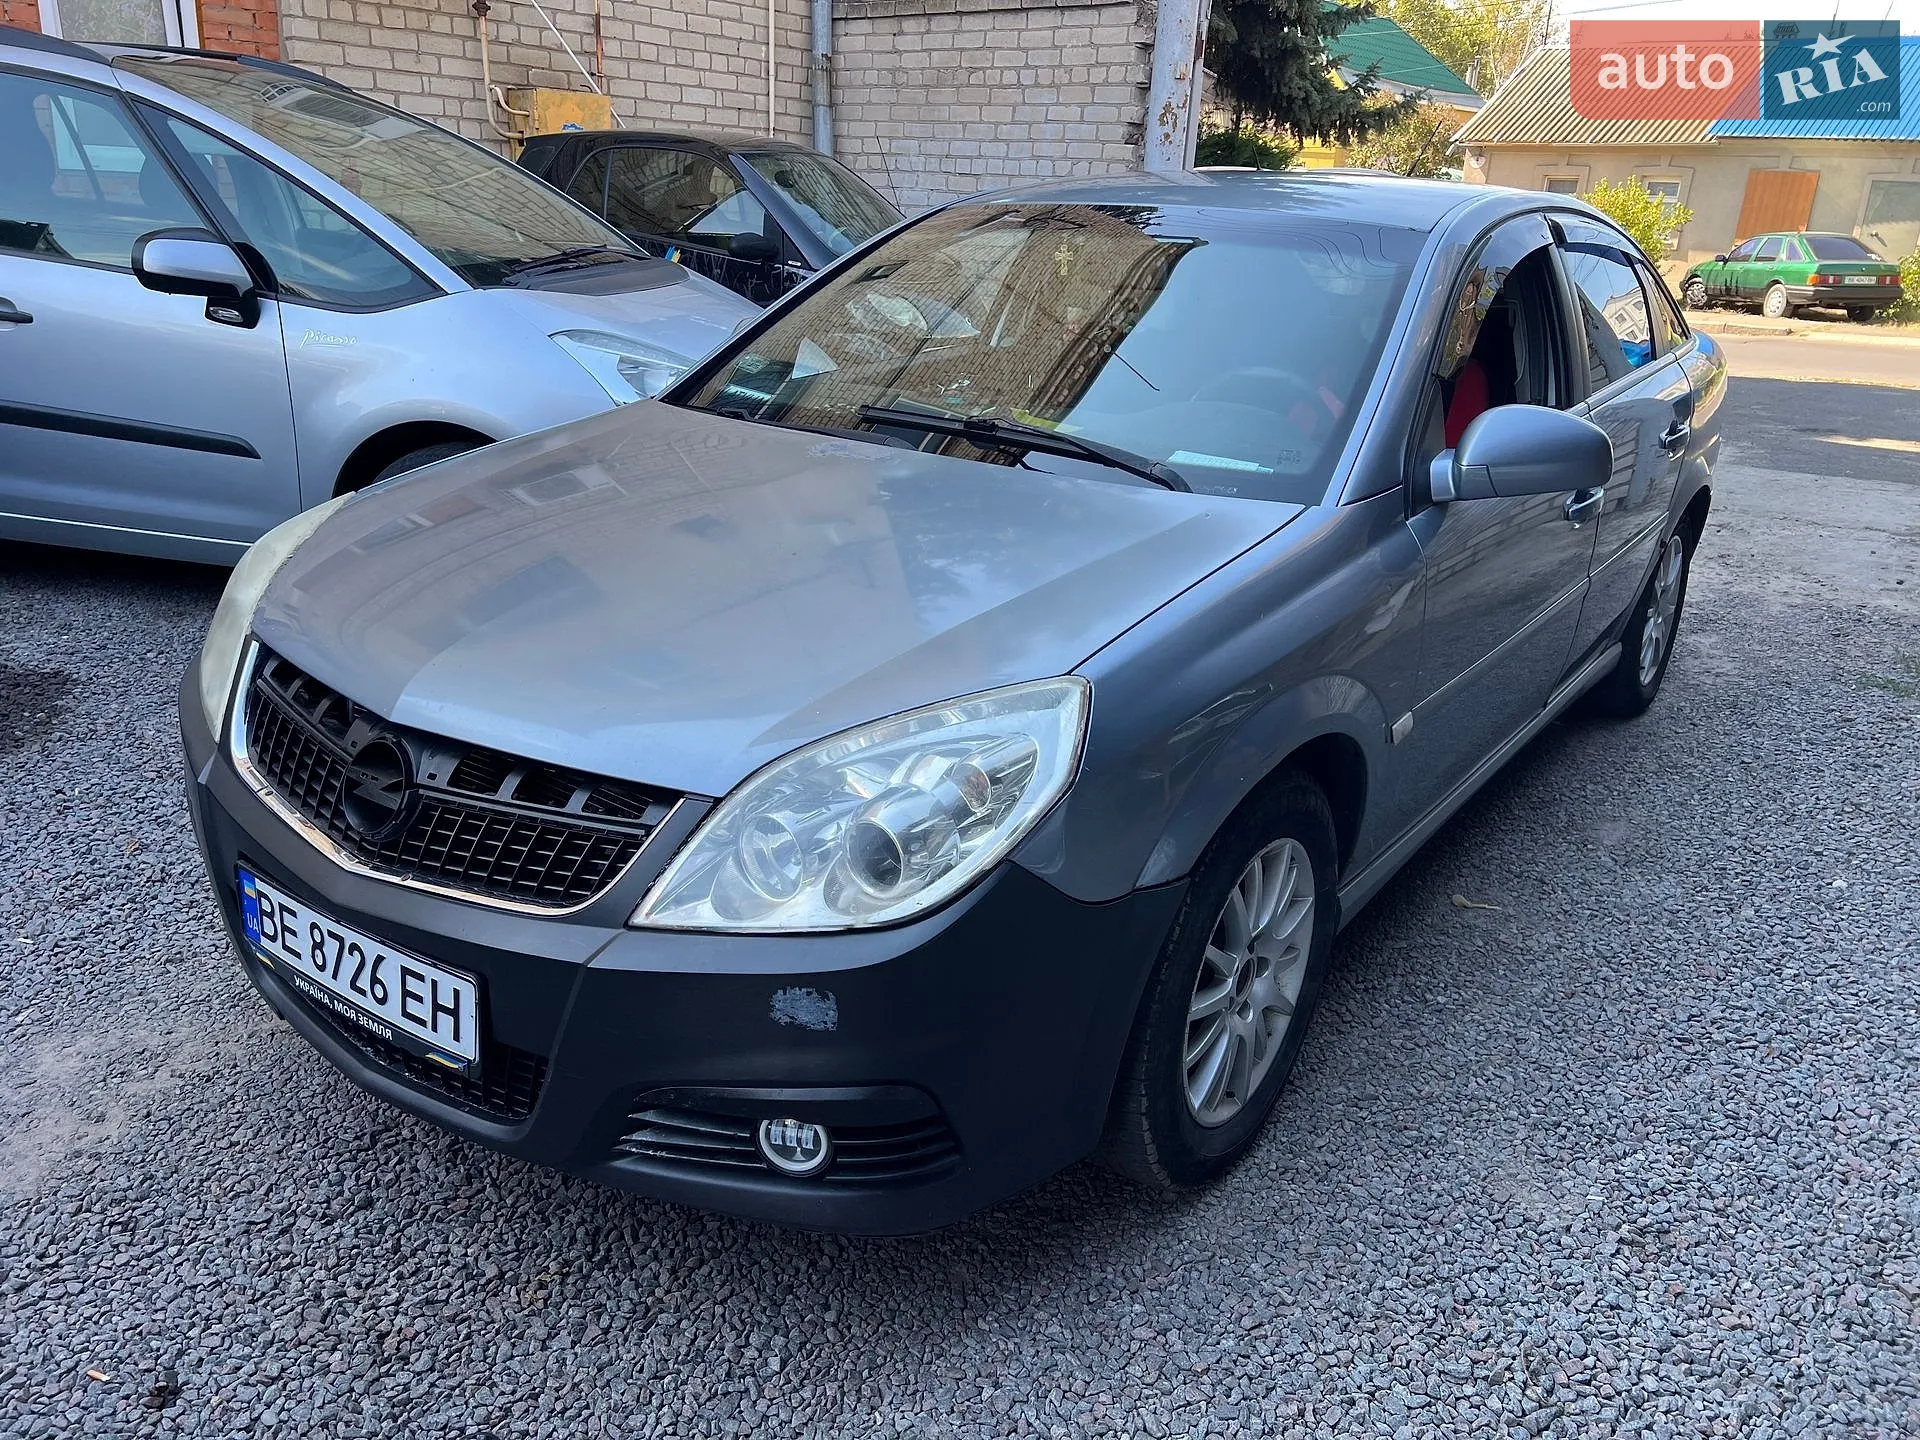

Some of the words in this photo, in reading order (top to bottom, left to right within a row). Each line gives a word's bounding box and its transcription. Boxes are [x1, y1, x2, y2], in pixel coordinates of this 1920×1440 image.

[299, 328, 358, 350] Picasso
[247, 911, 260, 934] UA
[257, 888, 301, 960] BE
[309, 921, 388, 1006] 8726
[400, 963, 461, 1043] EH
[293, 974, 334, 1011] УКРАЇНА,
[333, 1001, 357, 1022] МОЯ
[357, 1014, 393, 1041] ЗЕМЛЯ
